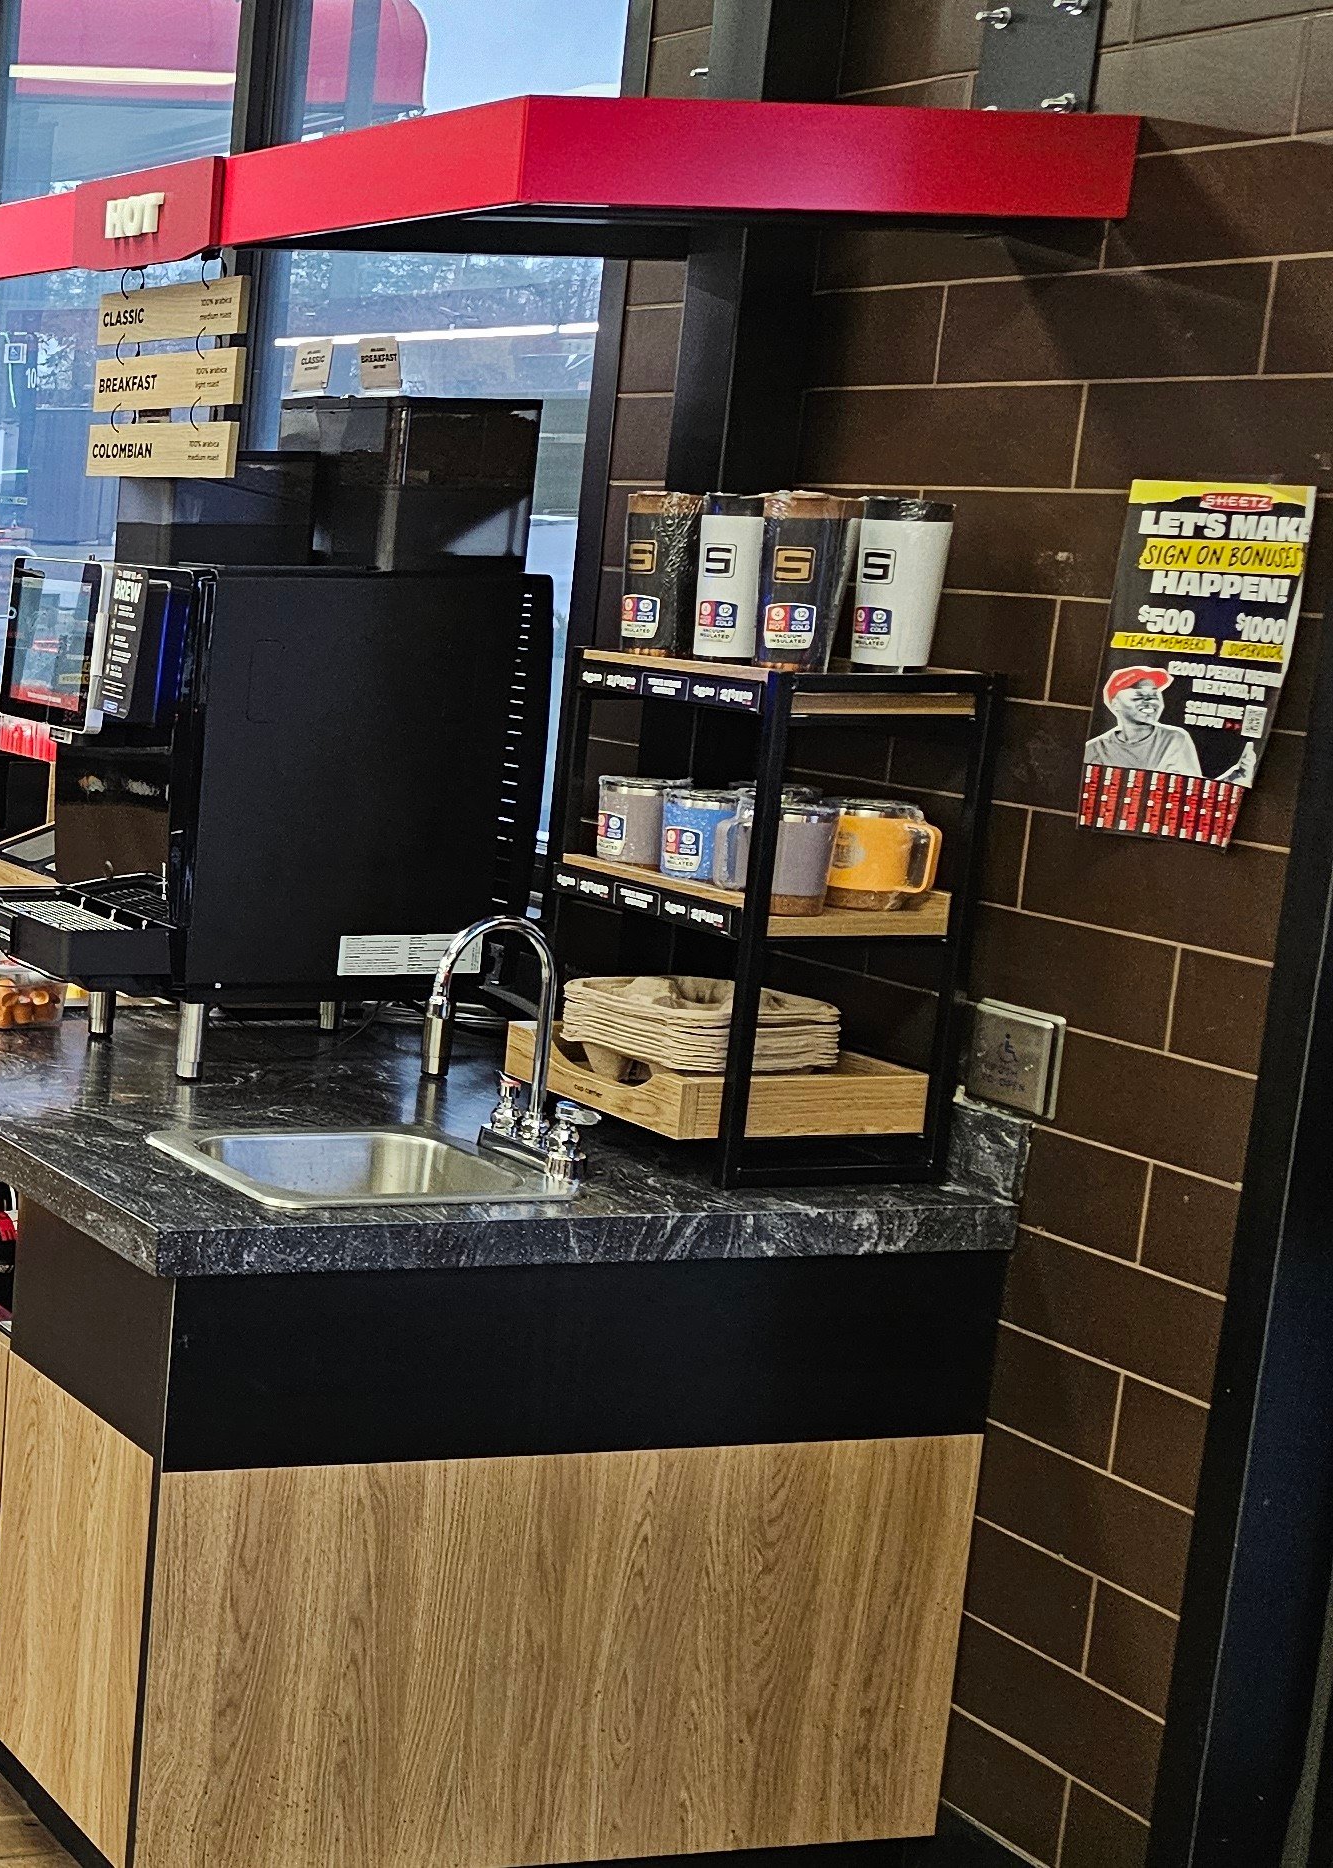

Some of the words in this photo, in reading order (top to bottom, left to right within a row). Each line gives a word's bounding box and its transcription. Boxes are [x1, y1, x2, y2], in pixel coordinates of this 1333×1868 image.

[104, 192, 165, 239] HOT
[103, 308, 145, 328] CLASSIC
[301, 355, 326, 366] CLASSIC
[361, 353, 397, 364] BREAKFAST
[26, 367, 36, 389] 10
[98, 374, 157, 394] BREAKFAST
[92, 443, 152, 460] COLOMBIAN
[1203, 495, 1270, 509] SHEETZ
[1138, 511, 1227, 538] LET'S
[705, 547, 733, 574] S
[775, 550, 812, 580] S
[863, 551, 891, 580] S
[1144, 544, 1191, 565] SIGN
[1197, 546, 1222, 566] ON
[1228, 546, 1301, 569] BONUSES
[113, 579, 142, 604] BREW
[1150, 571, 1290, 604] HAPPEN!
[722, 606, 730, 614] 12
[797, 609, 806, 617] 12
[876, 611, 885, 620] 12
[1138, 605, 1195, 635] $500
[1236, 613, 1287, 645] $1000
[1124, 635, 1155, 648] TEAM
[1159, 638, 1207, 652] MEMBERS
